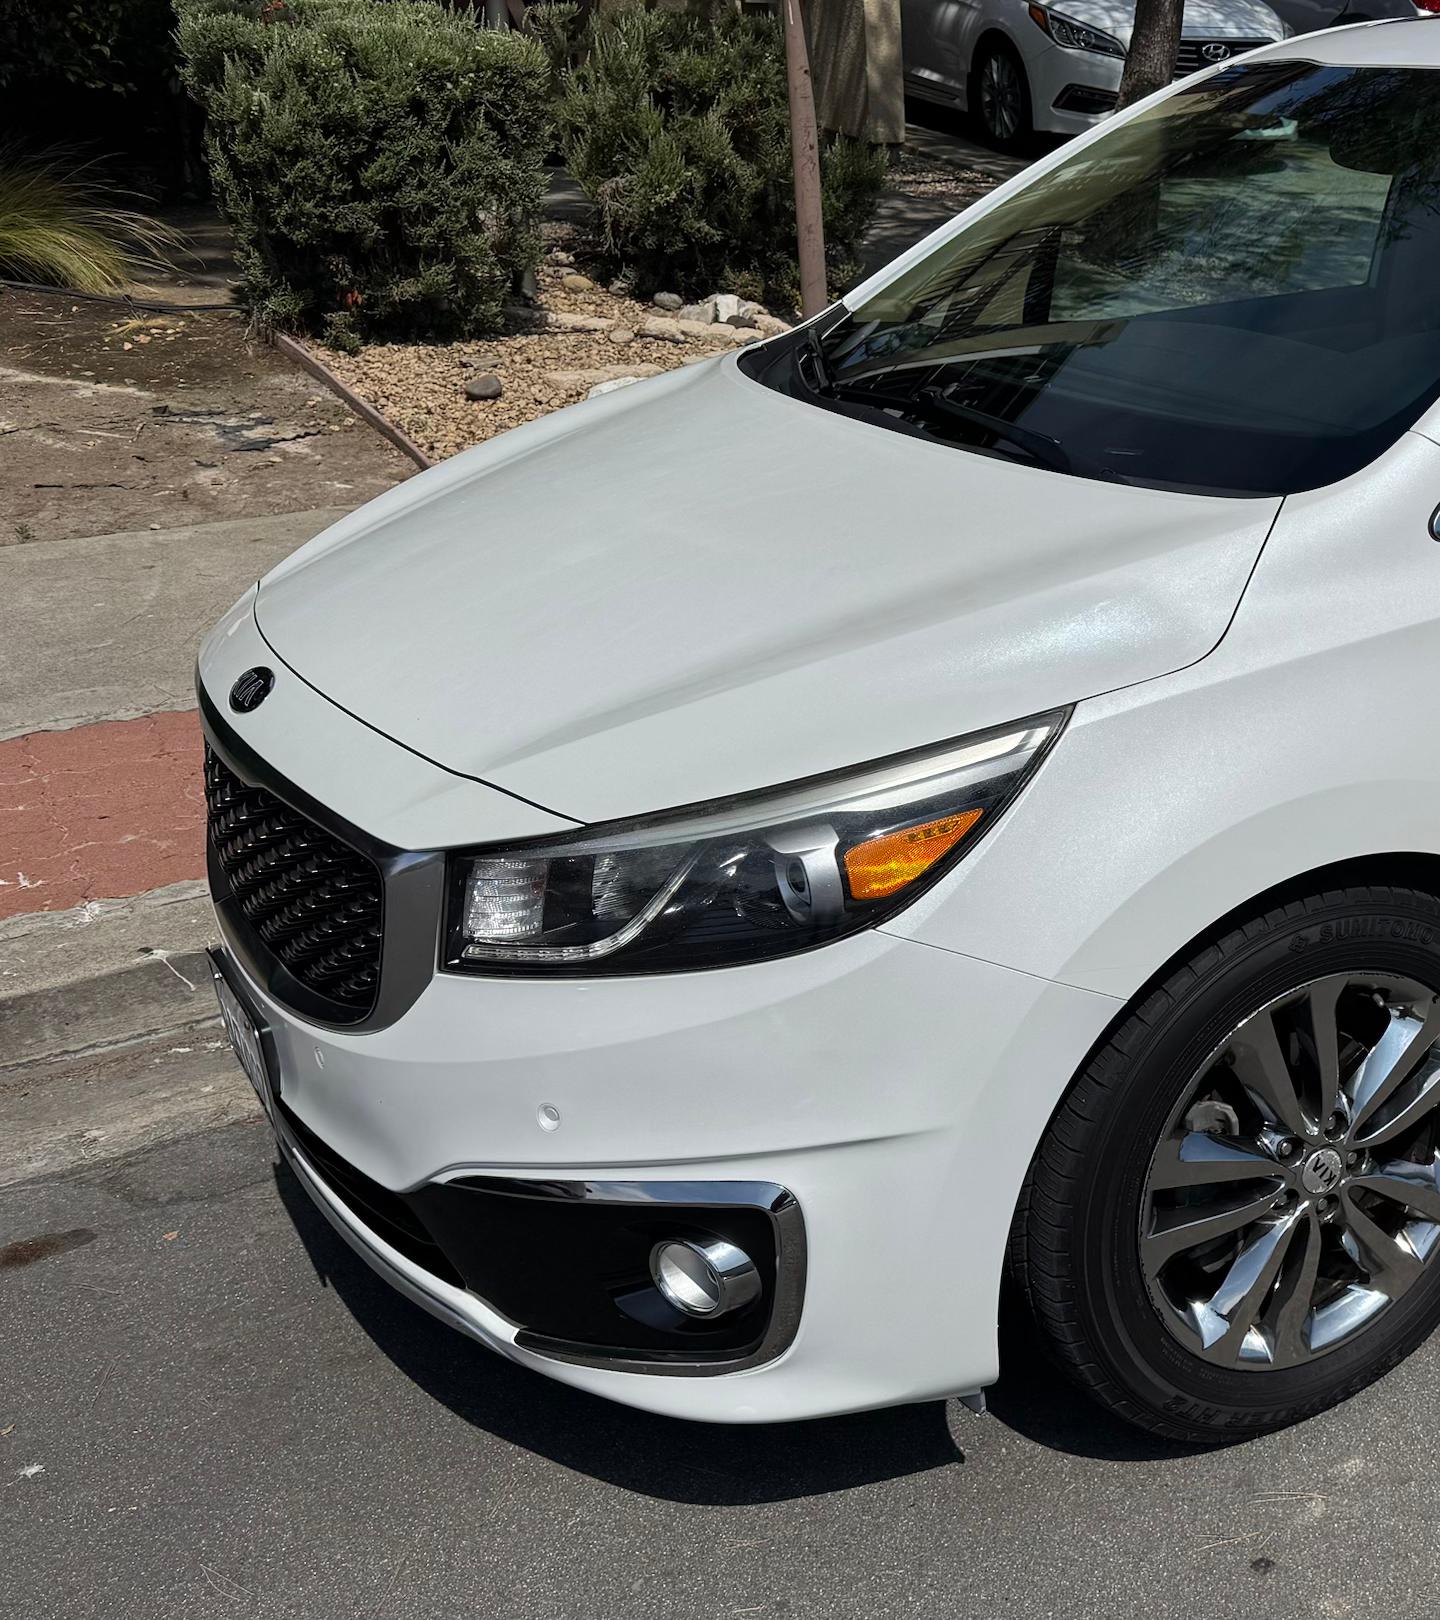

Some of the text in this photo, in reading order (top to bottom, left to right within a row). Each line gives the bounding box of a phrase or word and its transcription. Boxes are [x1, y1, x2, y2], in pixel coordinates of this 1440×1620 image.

[1320, 917, 1434, 944] SUMITOMO
[1312, 1154, 1337, 1187] KIA
[1163, 1395, 1219, 1425] HT2
